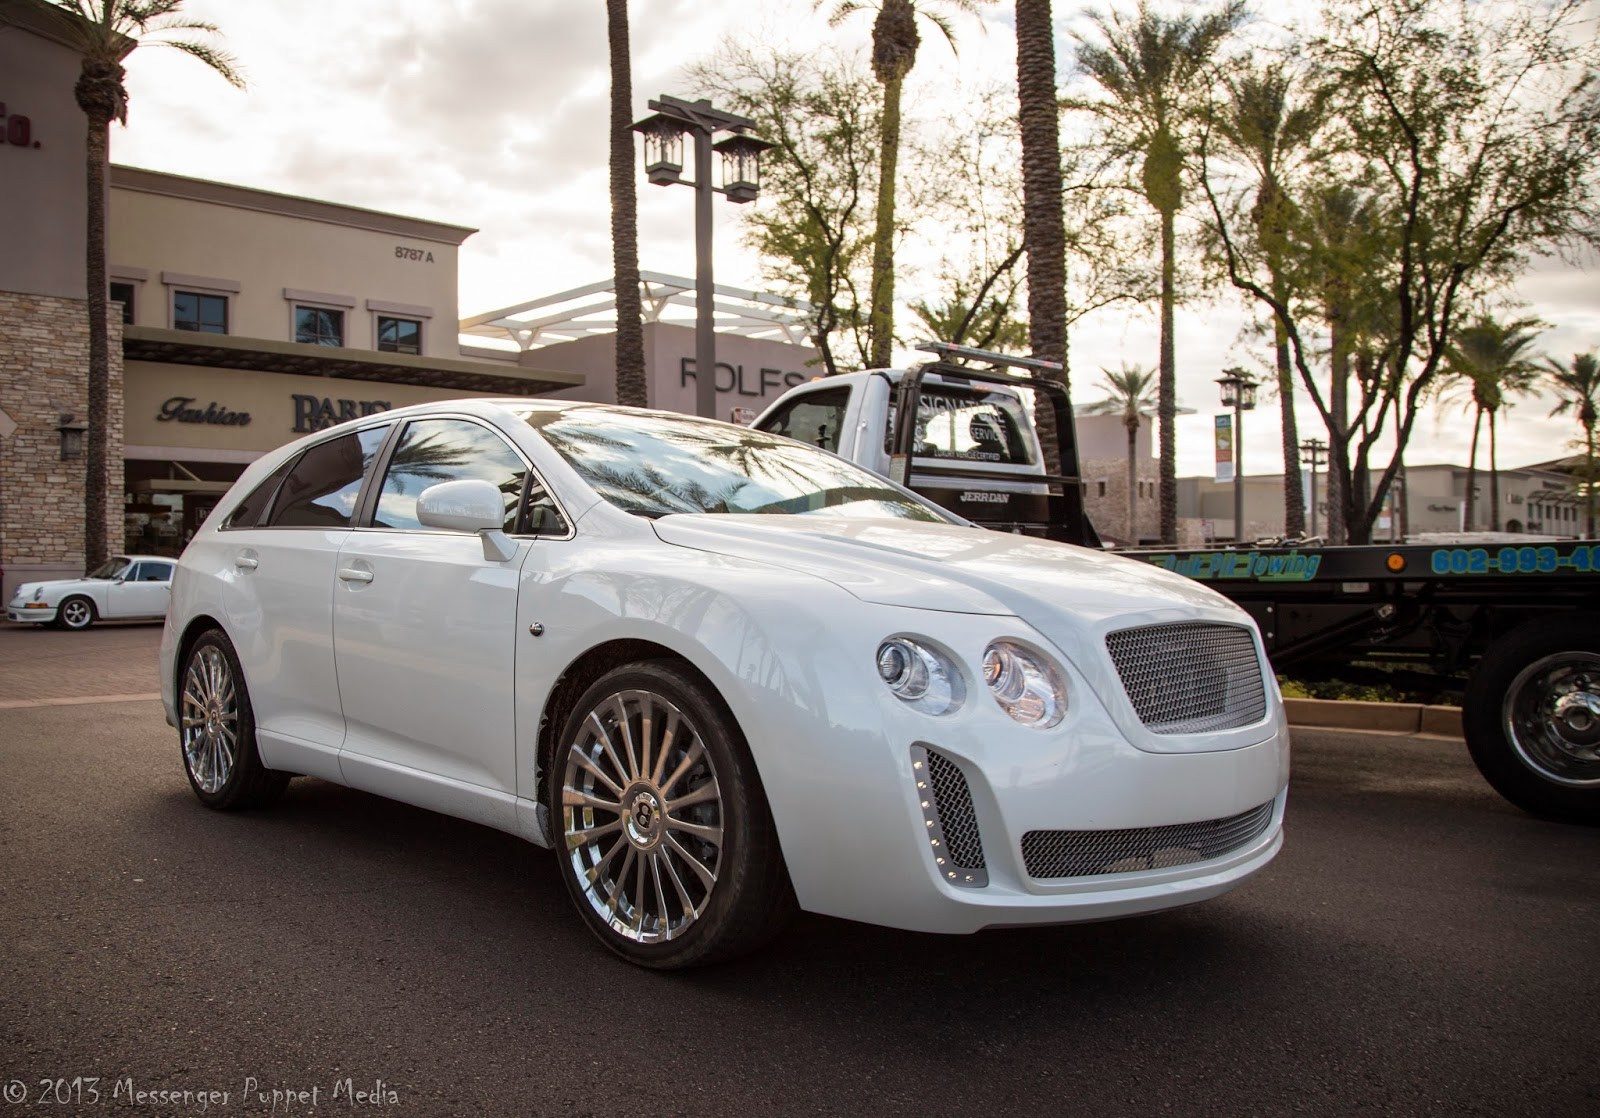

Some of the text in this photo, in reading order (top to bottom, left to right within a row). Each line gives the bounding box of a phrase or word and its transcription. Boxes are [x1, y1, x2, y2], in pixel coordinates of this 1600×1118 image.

[395, 246, 434, 263] 8787 A
[156, 396, 251, 426] Fashion
